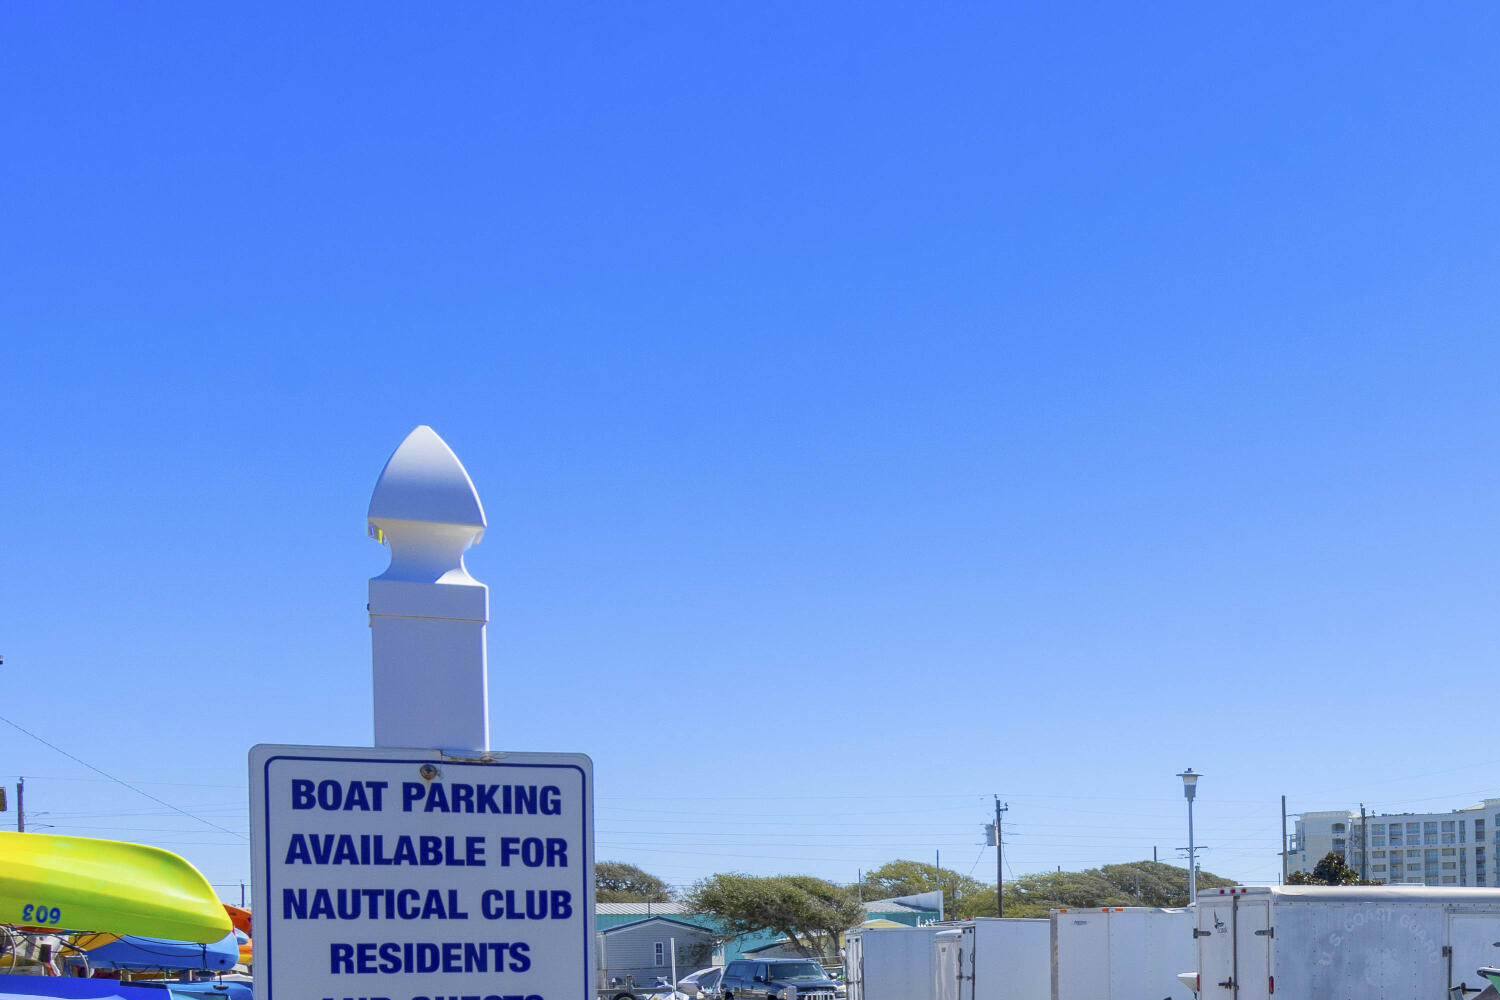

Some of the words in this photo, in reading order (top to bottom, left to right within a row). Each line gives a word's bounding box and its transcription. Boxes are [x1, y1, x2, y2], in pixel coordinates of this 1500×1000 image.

[291, 779, 388, 811] BOAT
[402, 782, 562, 815] PARKING
[284, 834, 486, 866] AVAILABLE
[500, 837, 568, 867] FOR
[22, 903, 61, 924] 603
[283, 888, 468, 920] NAUTICAL
[481, 890, 573, 920] CLUB
[330, 942, 532, 974] RESIDENTS
